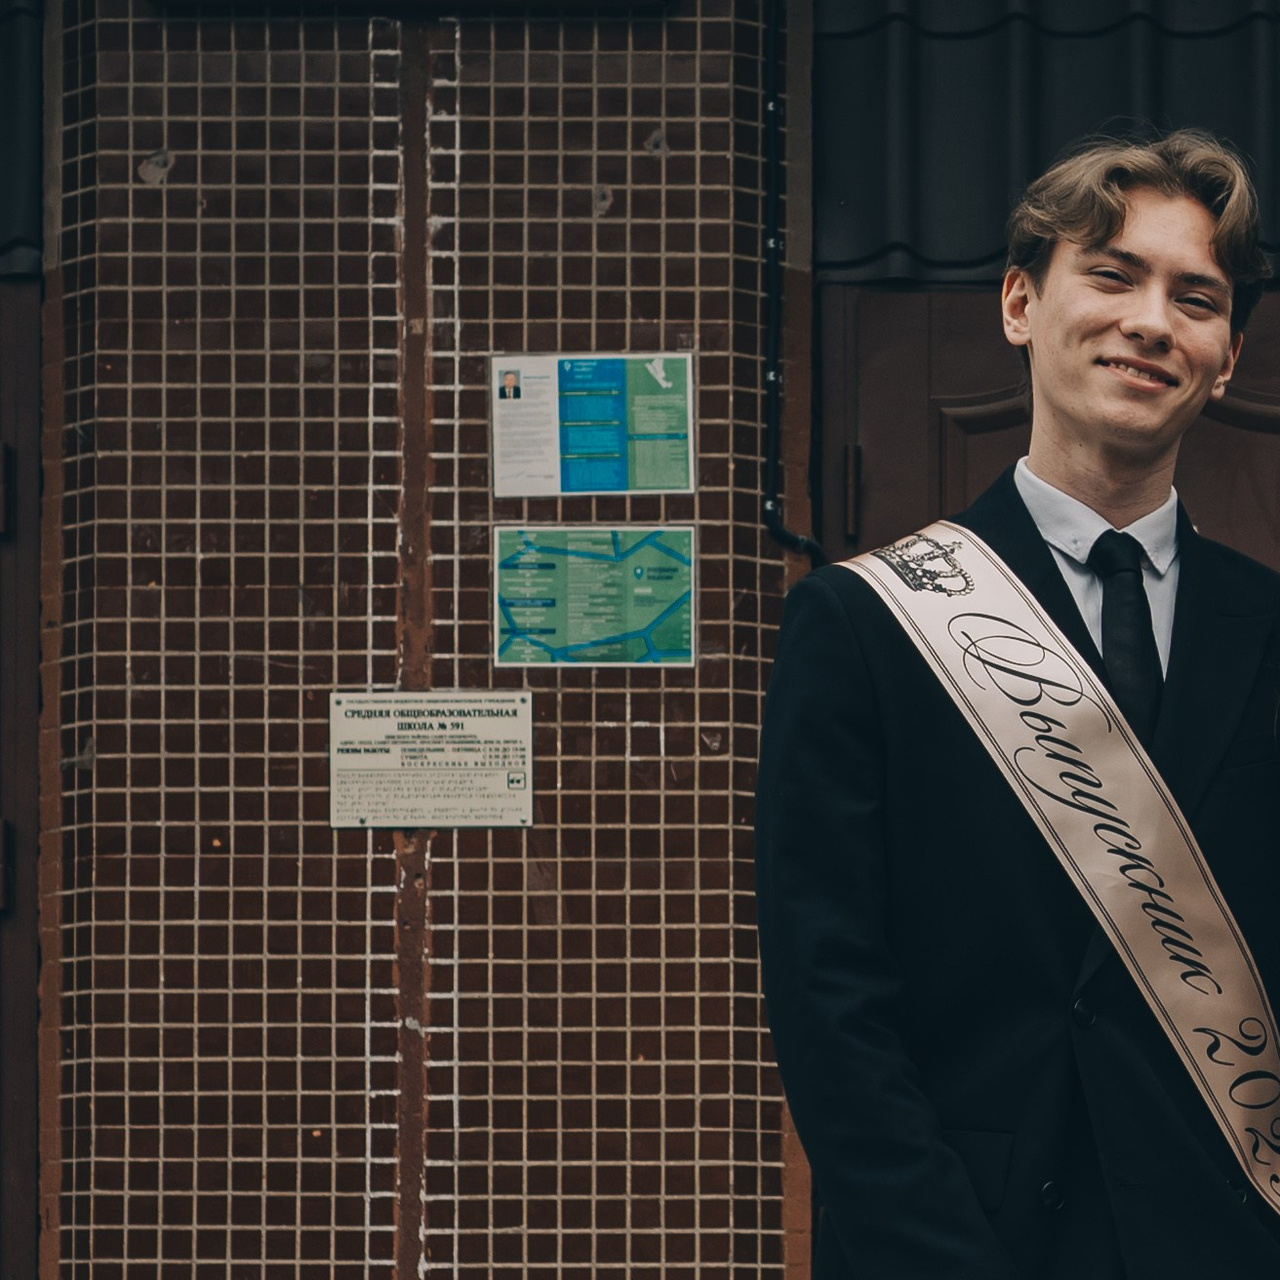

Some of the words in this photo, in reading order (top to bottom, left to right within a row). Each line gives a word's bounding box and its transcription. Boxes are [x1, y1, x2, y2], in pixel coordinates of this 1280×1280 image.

[344, 709, 391, 718] СРЕДНЯЯ
[393, 708, 518, 718] ОБЩЕОБРАЗОВАТЕЛЬНАЯ
[397, 722, 434, 731] ШКОЛА
[437, 722, 447, 731] №
[450, 722, 465, 731] 591
[947, 611, 1223, 997] Выпускник
